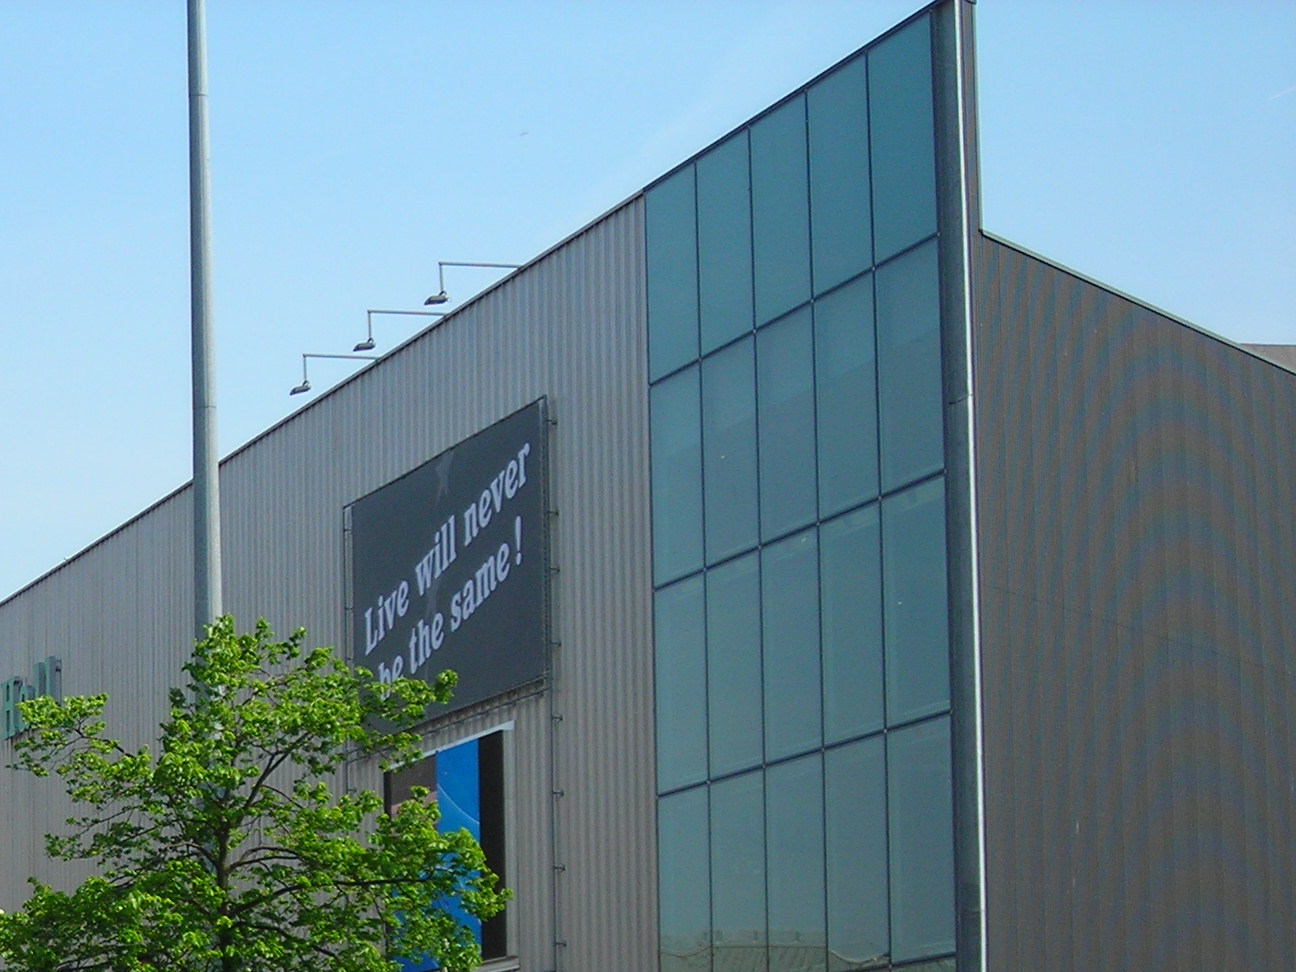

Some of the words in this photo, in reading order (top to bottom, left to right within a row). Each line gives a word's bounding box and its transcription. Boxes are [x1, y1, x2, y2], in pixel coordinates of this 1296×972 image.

[365, 580, 409, 656] Live
[415, 515, 456, 596] will
[464, 442, 531, 547] never
[409, 612, 444, 674] the
